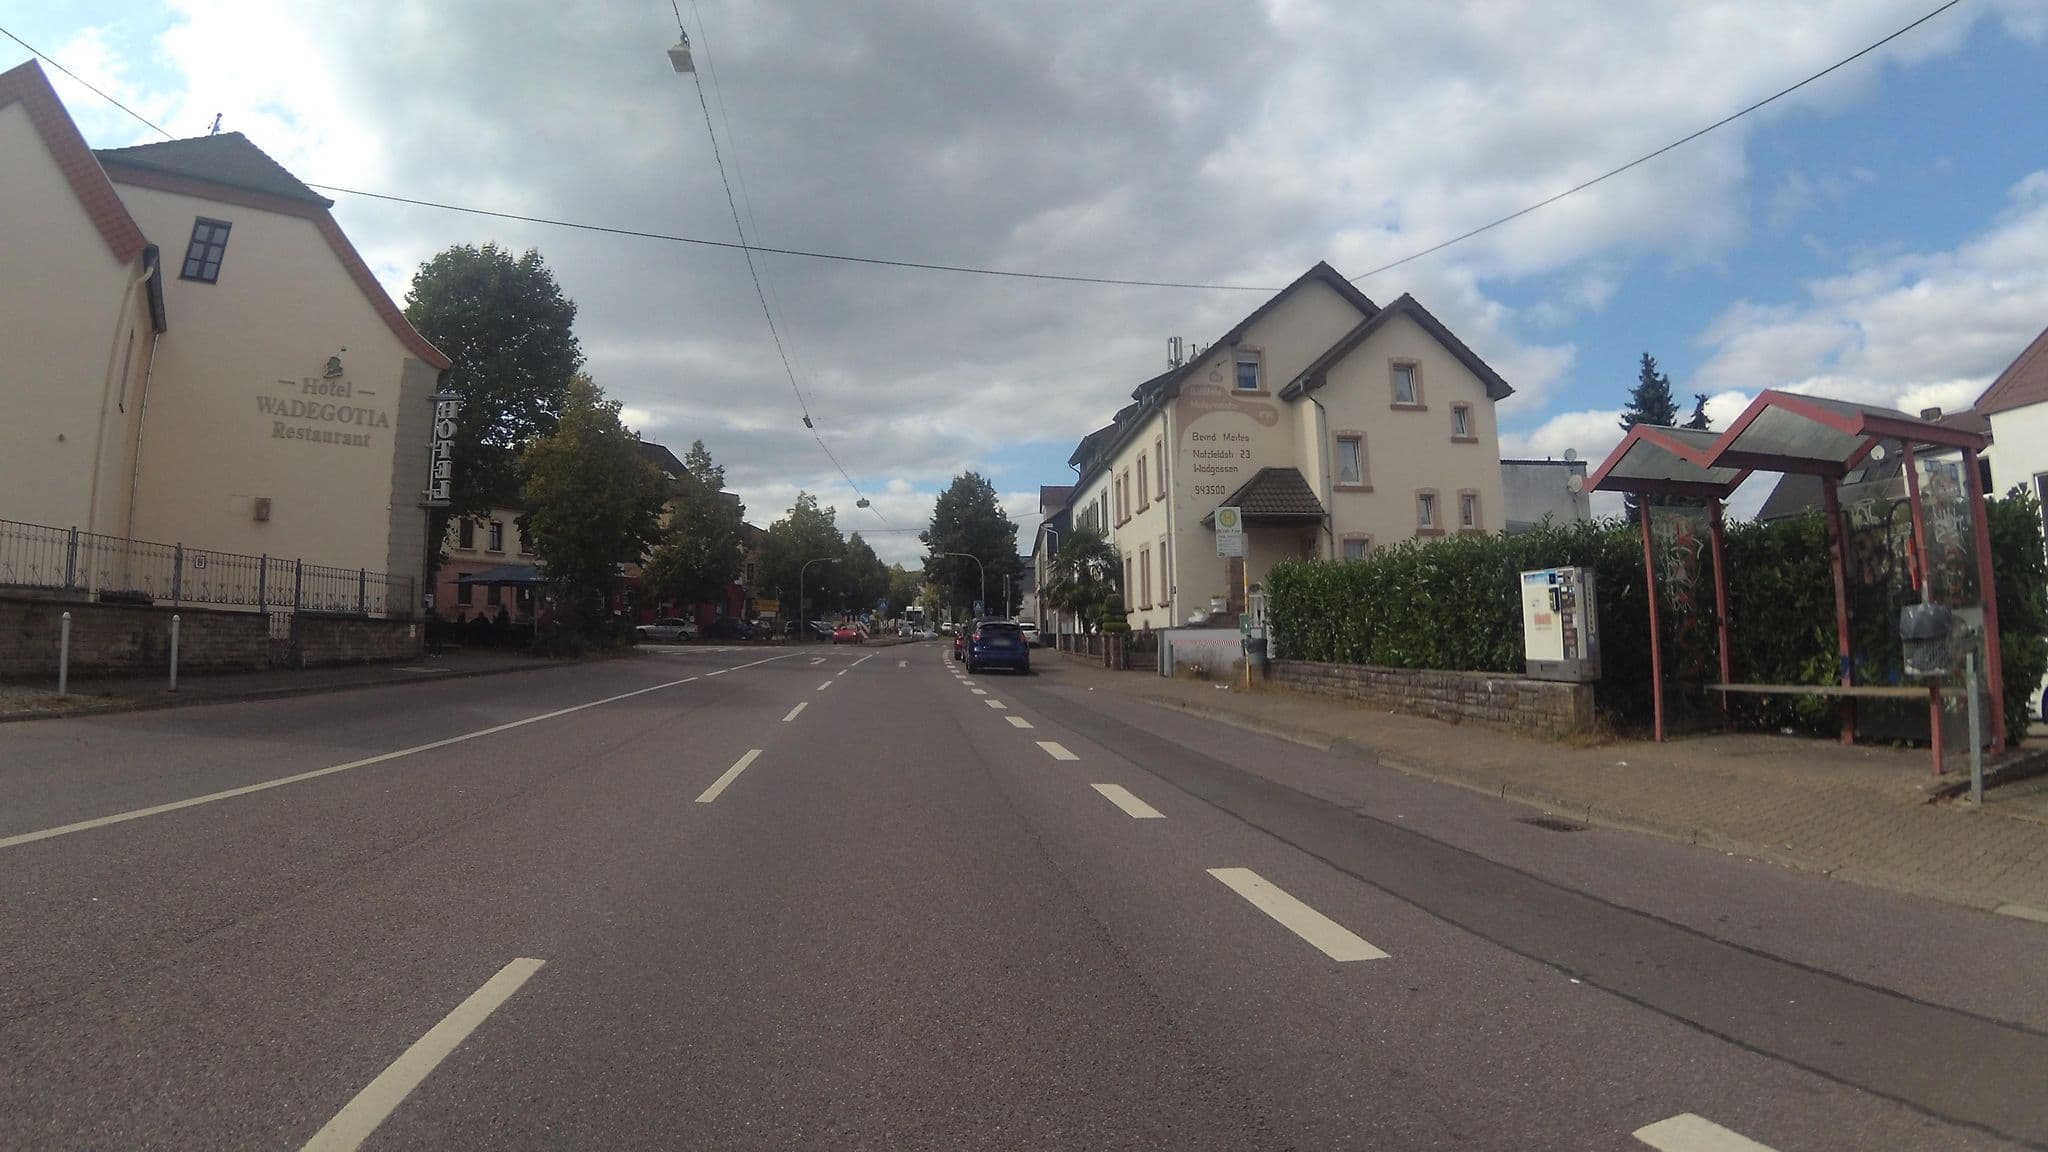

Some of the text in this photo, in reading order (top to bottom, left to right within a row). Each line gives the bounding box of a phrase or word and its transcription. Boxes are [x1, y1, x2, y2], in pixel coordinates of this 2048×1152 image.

[302, 377, 352, 398] Hotel
[256, 396, 389, 428] WADEGOTIA
[272, 421, 371, 447] Restaurant
[1192, 432, 1216, 442] Bernd
[433, 400, 460, 499] HOTEL
[1240, 449, 1251, 459] 23
[1193, 463, 1238, 476] Wadgassen
[1195, 485, 1226, 496] 943500
